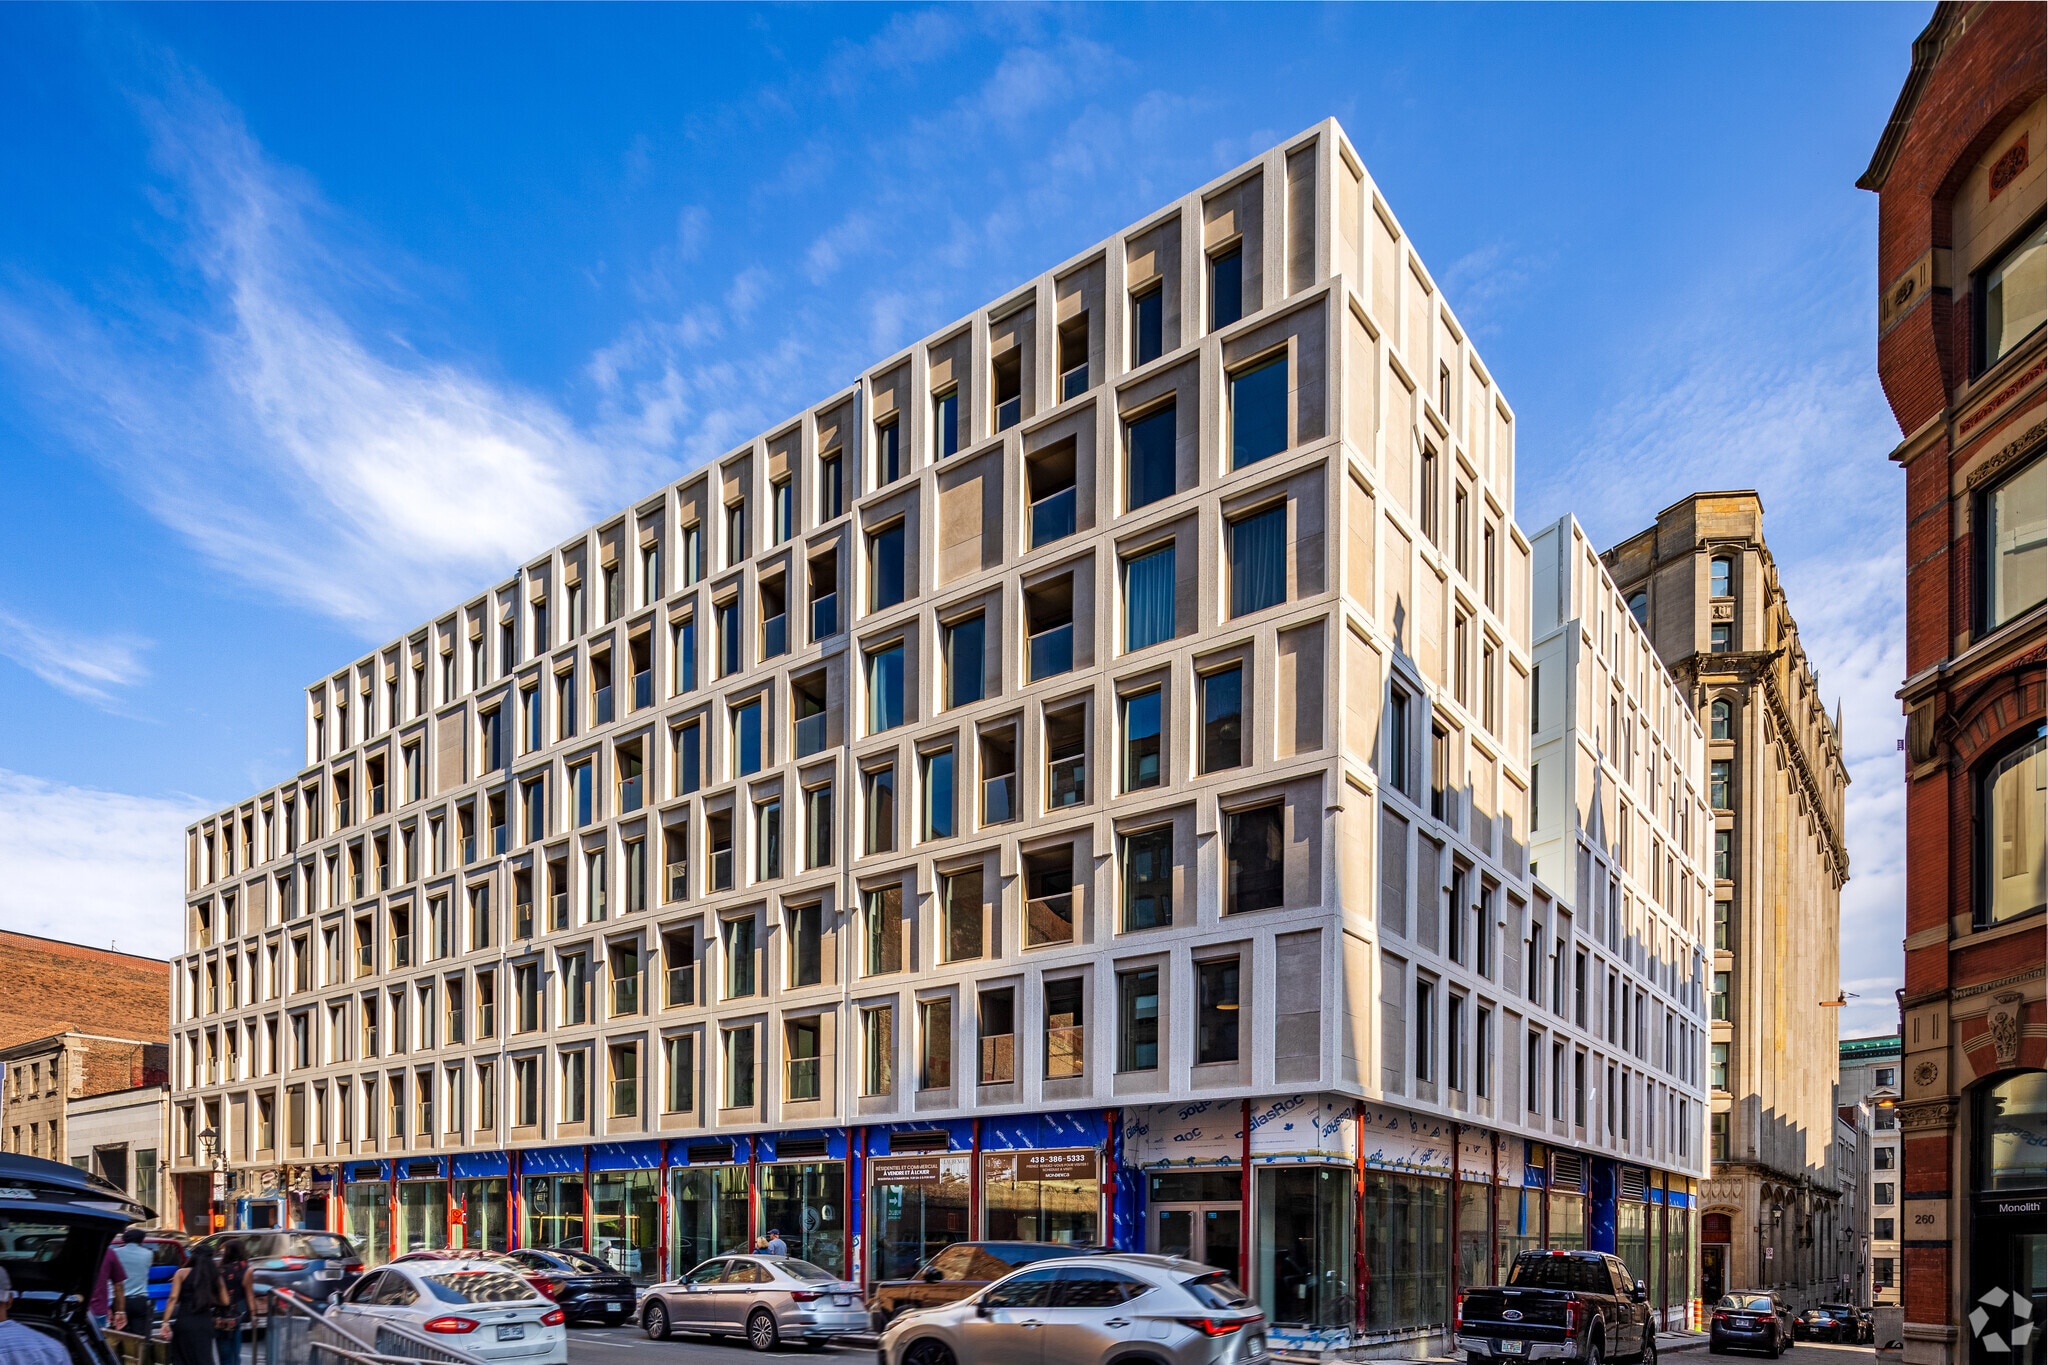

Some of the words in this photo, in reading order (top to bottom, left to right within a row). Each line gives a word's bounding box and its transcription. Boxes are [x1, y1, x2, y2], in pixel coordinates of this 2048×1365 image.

[1030, 1155, 1085, 1163] 438-386-5333
[1999, 1202, 2040, 1212] Monolith
[1915, 1215, 1935, 1224] 260
